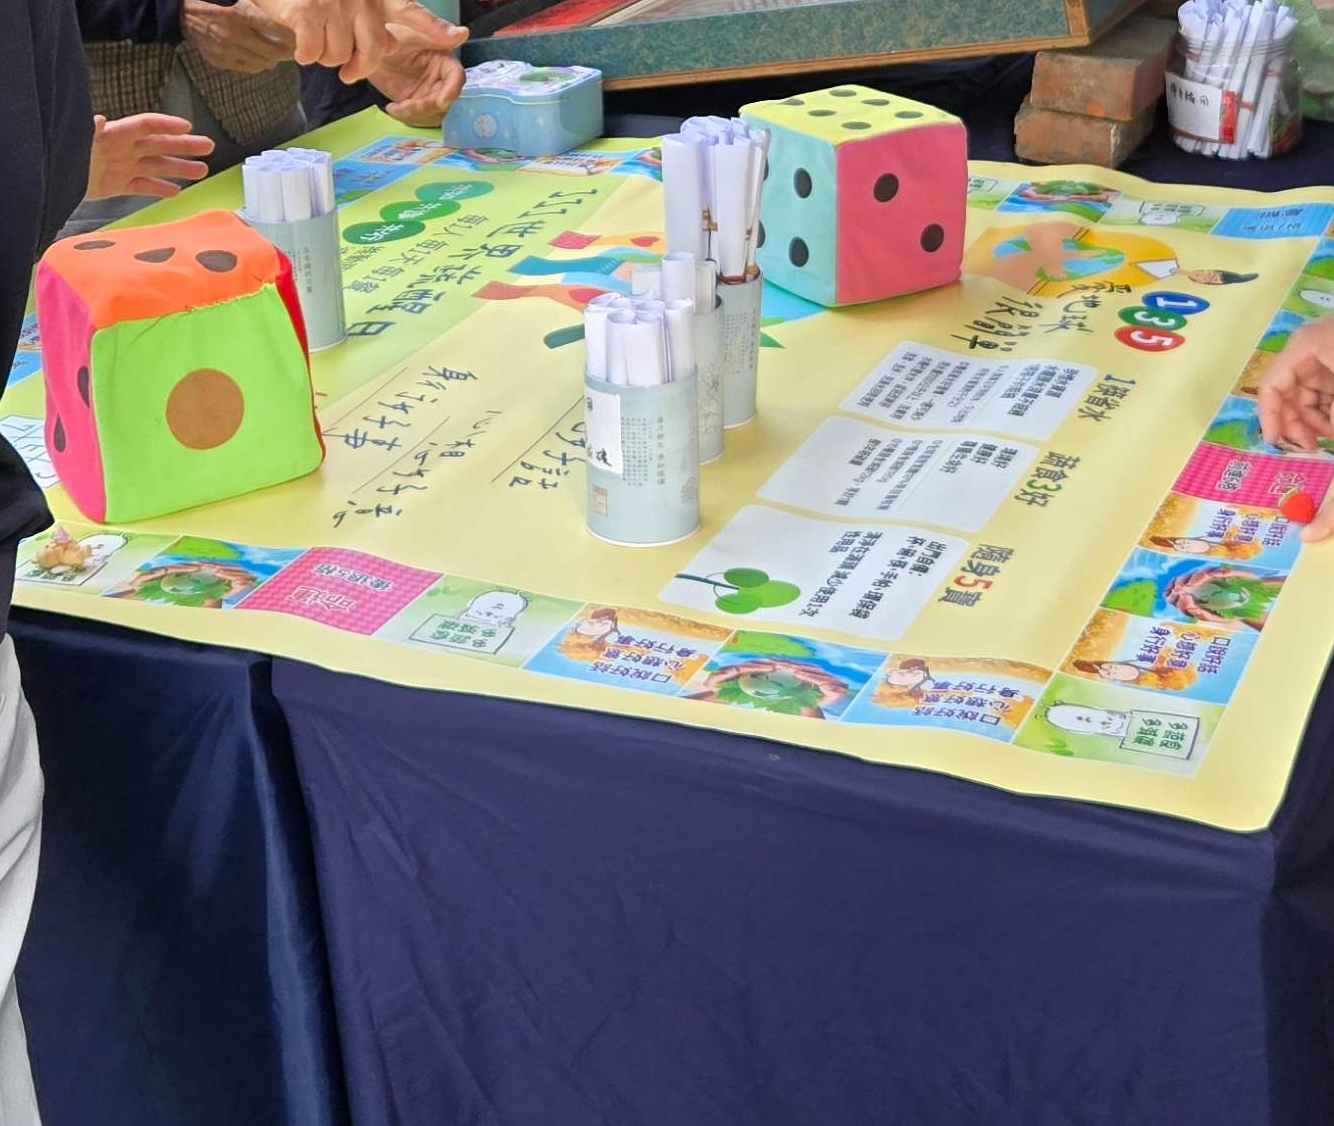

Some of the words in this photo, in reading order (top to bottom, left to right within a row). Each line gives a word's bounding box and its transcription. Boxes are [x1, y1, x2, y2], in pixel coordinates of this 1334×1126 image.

[950, 295, 1040, 352] 很簡單
[1037, 281, 1132, 333] 愛地球
[1014, 451, 1081, 507] 蔬食3好
[937, 543, 1015, 608] 隨身5寶
[283, 584, 356, 612] 命運
[1136, 627, 1170, 664] 身行好事
[1197, 636, 1232, 674] 口說好話
[589, 661, 672, 683] 口說好話
[911, 706, 1001, 727] 口說好話
